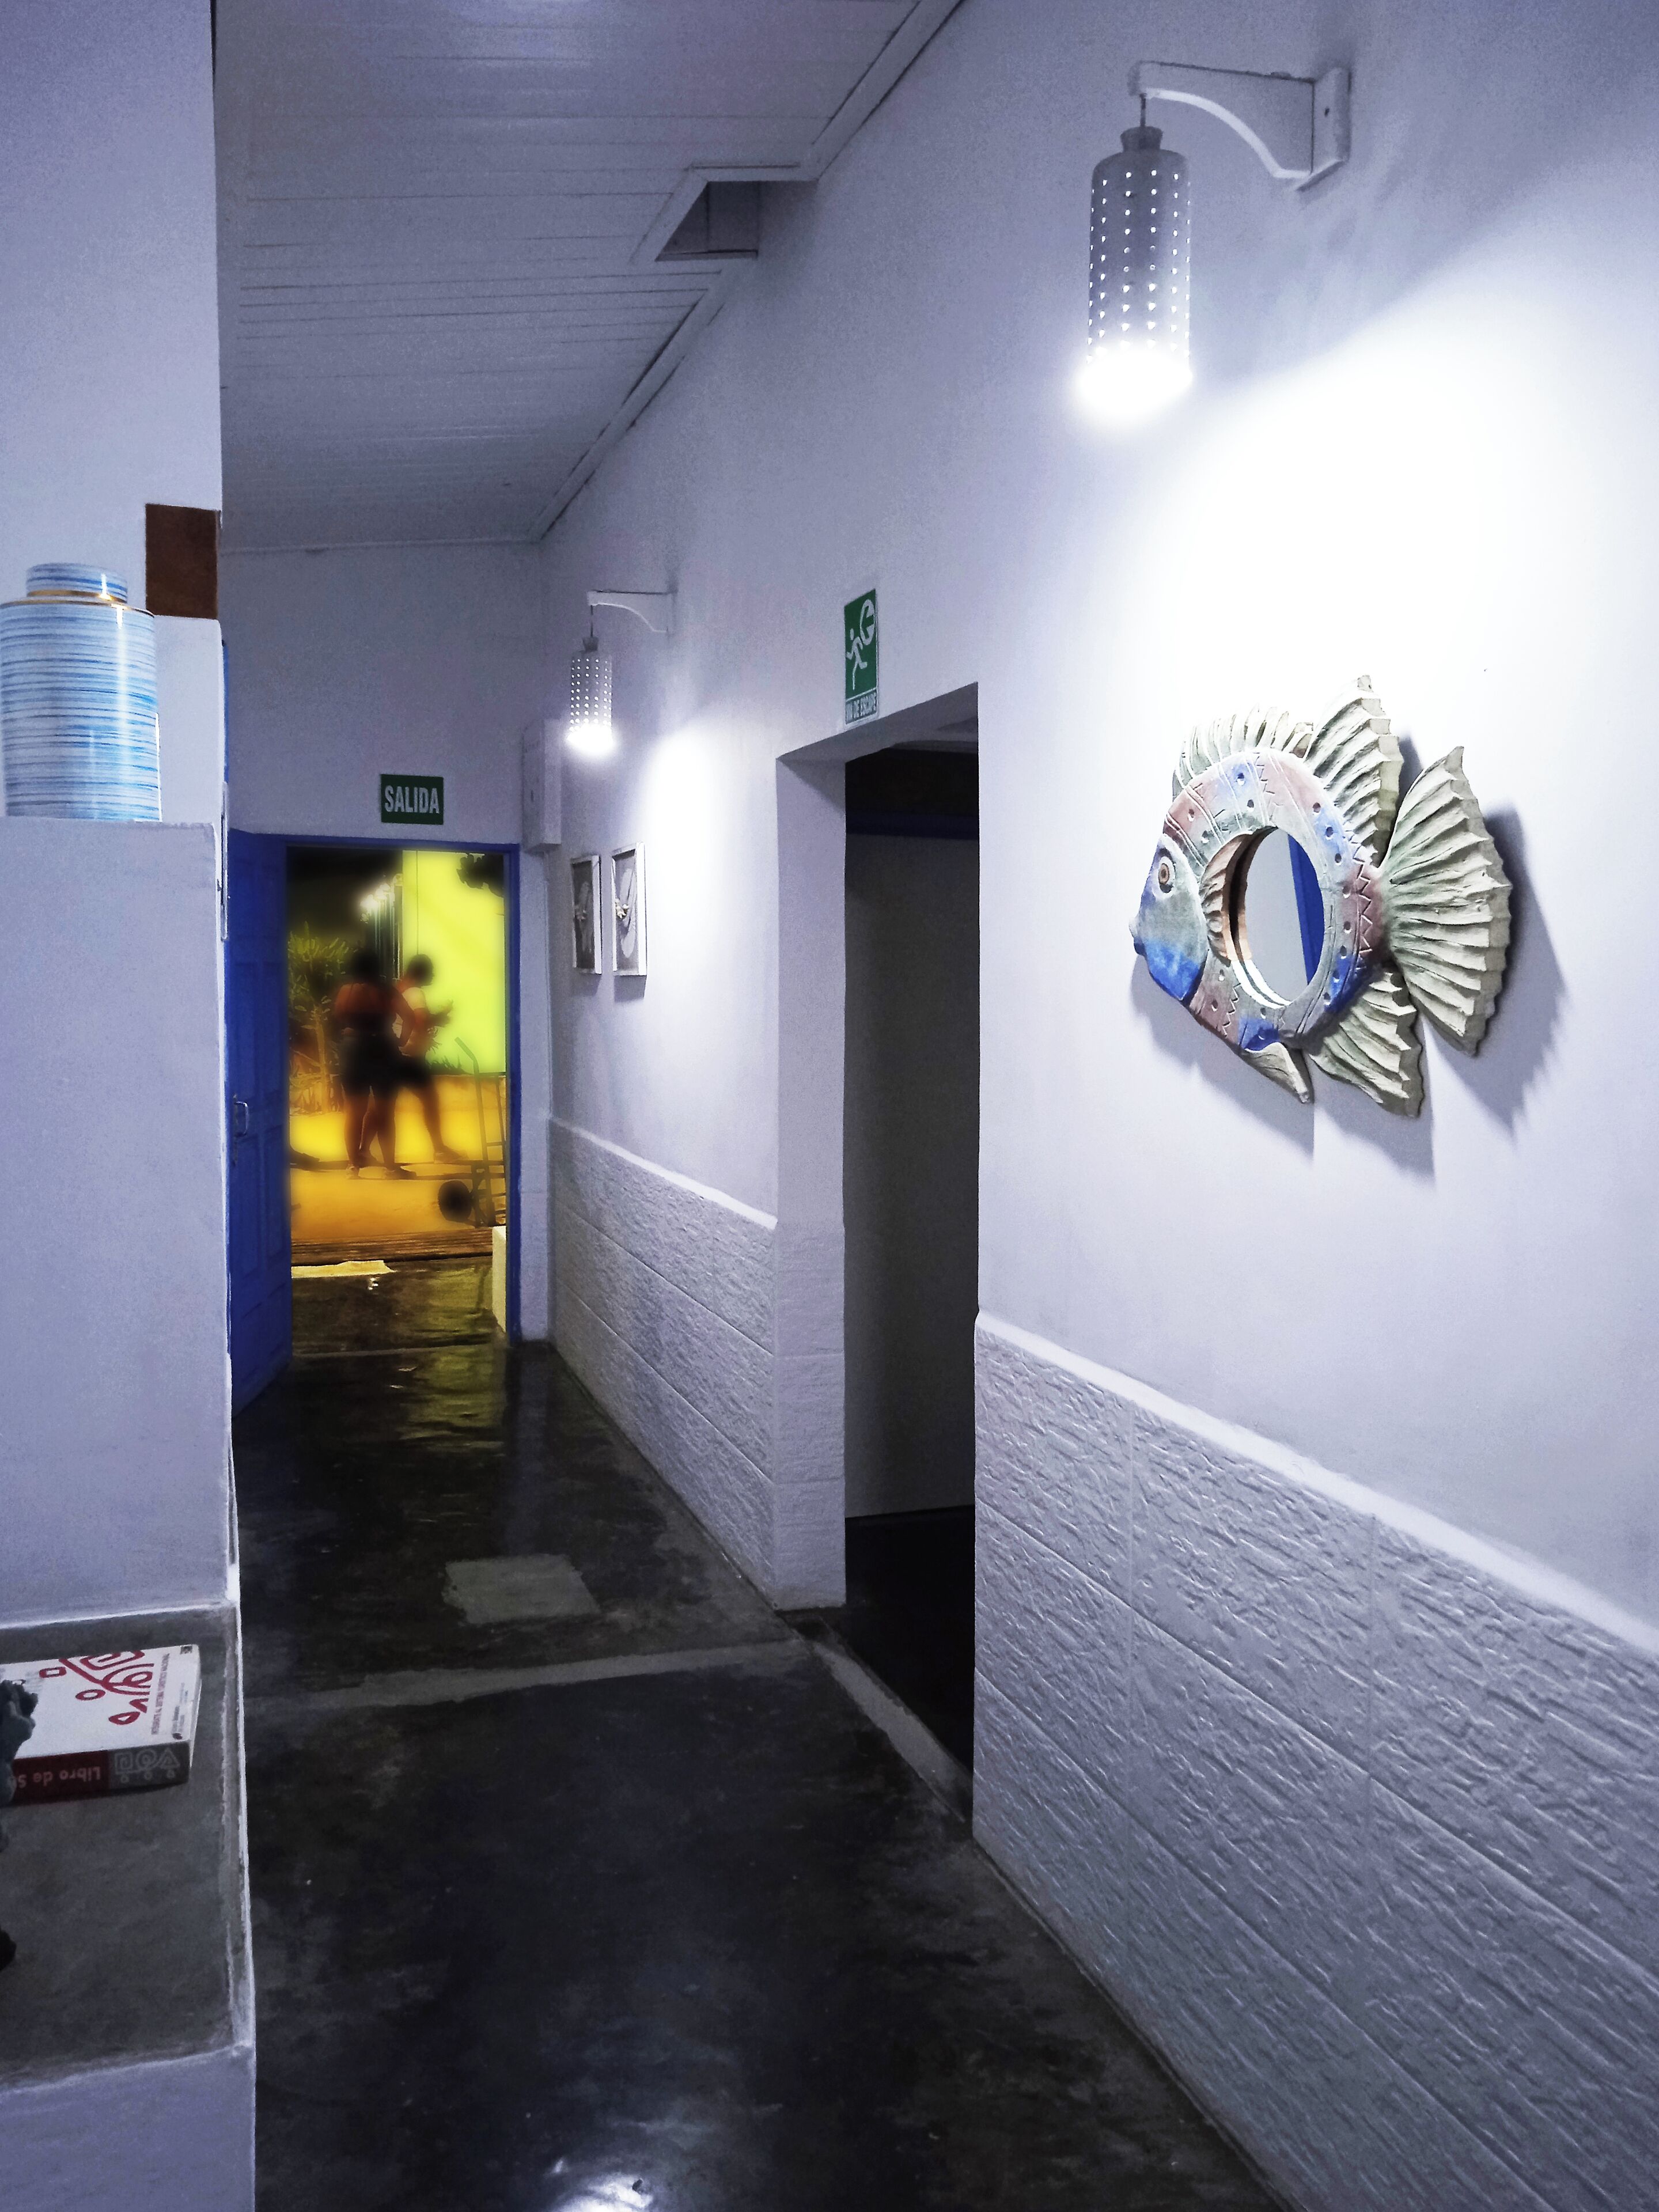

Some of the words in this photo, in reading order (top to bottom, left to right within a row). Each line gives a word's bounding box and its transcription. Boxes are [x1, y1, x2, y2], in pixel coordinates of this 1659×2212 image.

[384, 785, 440, 813] SALIDA
[32, 1771, 53, 1786] de
[59, 1766, 101, 1783] Libro
